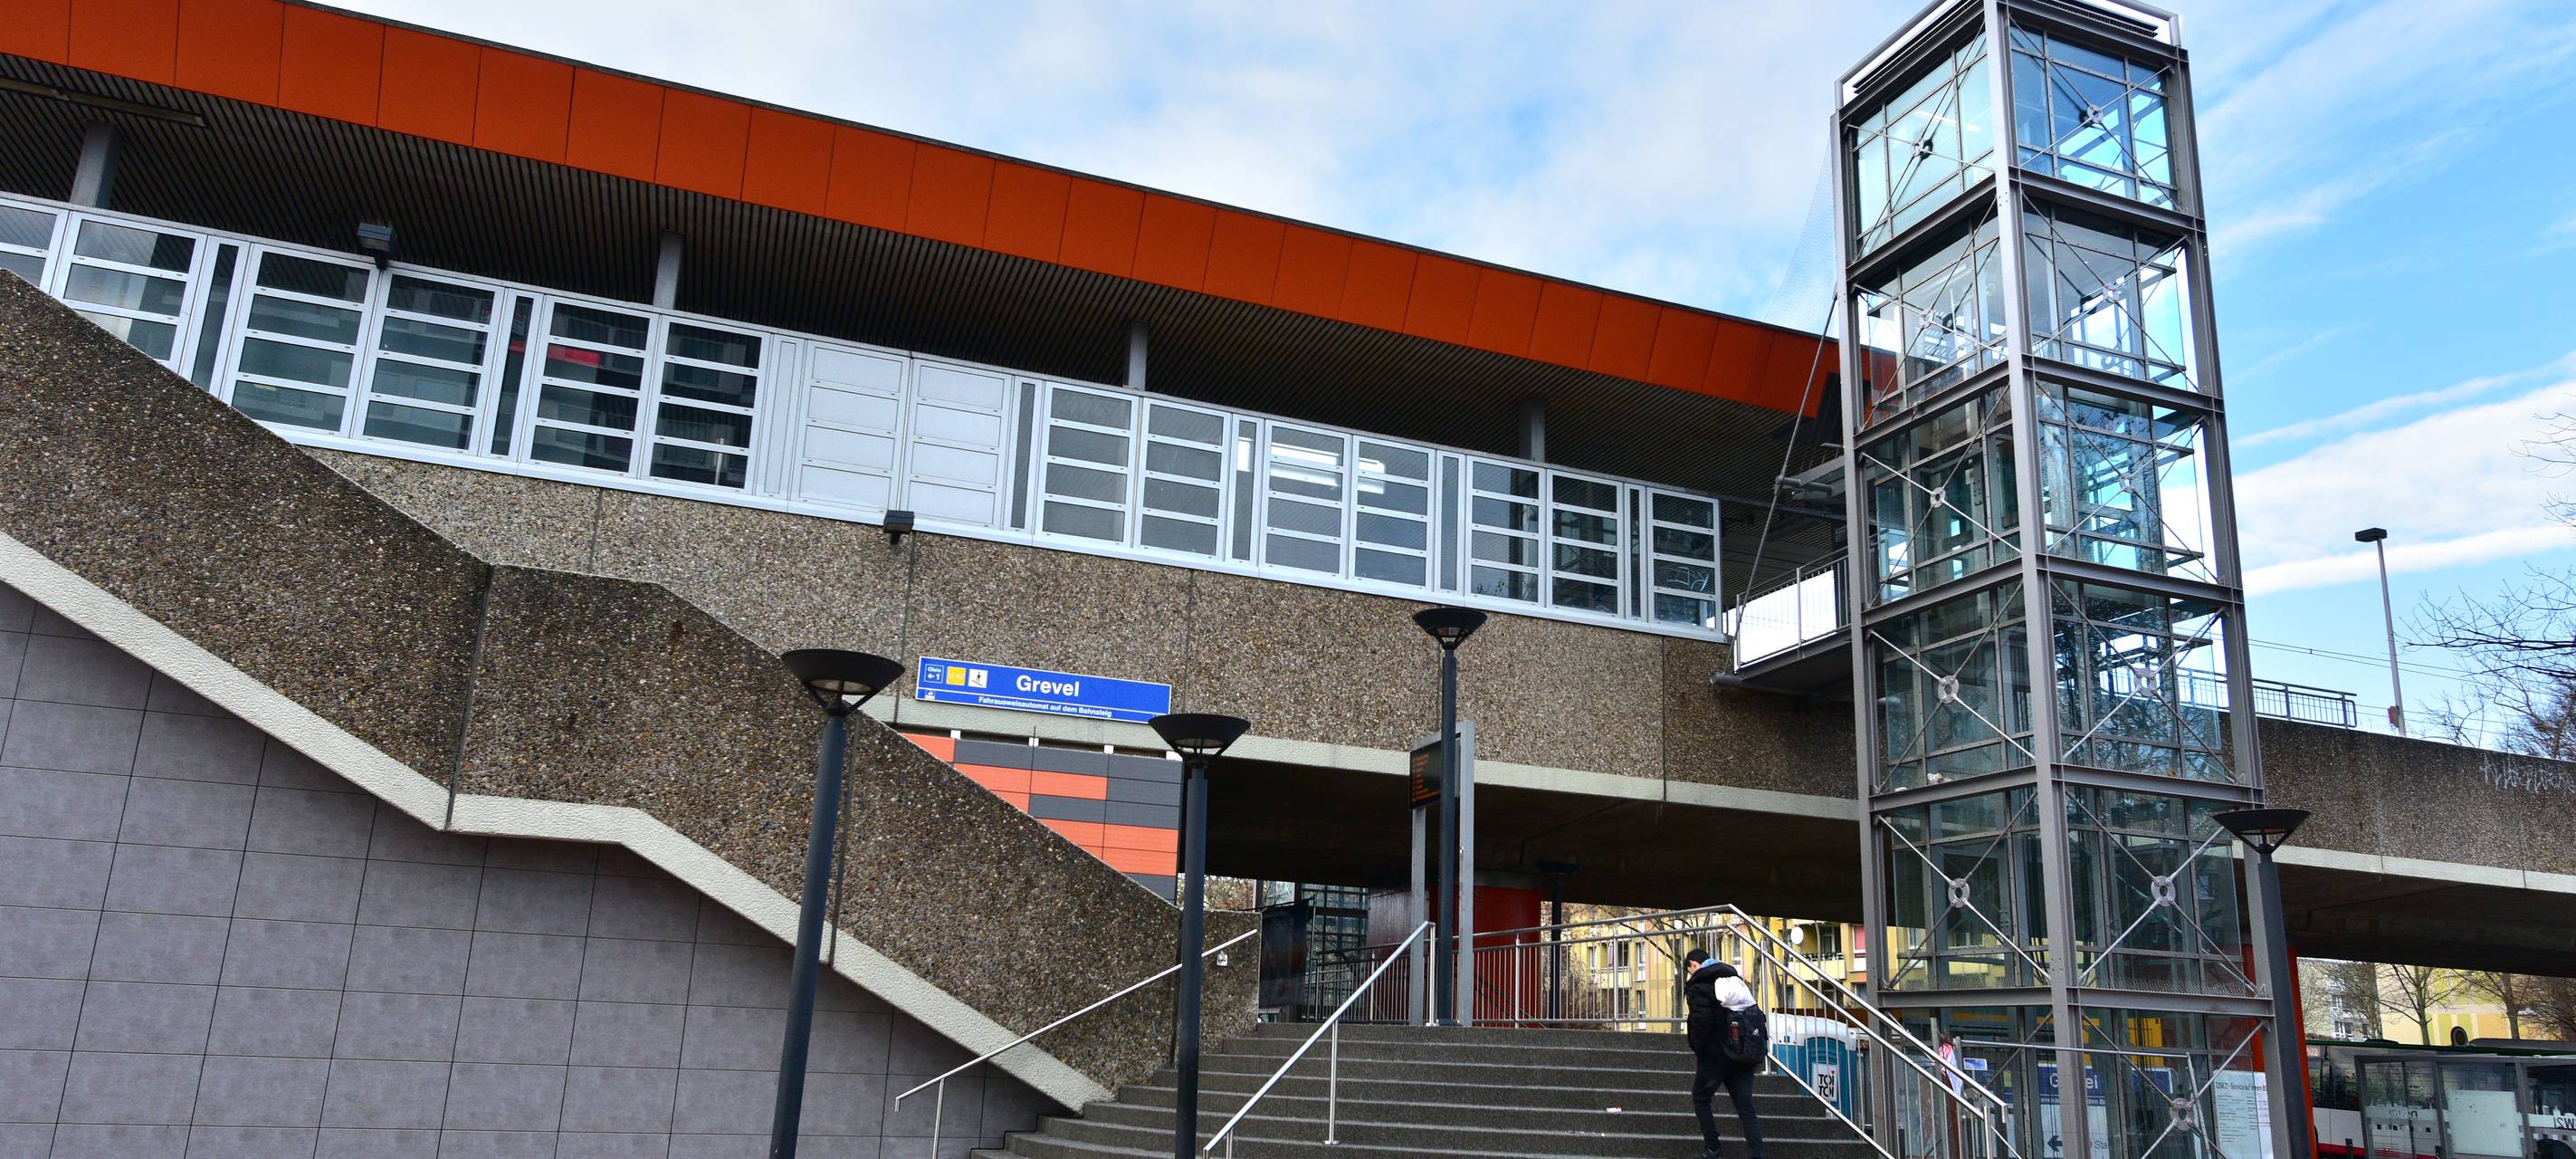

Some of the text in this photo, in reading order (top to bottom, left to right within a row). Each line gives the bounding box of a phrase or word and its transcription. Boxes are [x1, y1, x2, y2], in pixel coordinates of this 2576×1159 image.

[1016, 675, 1080, 697] Grevel
[978, 696, 1049, 711] Fahrausweisautomat
[1079, 708, 1112, 718] Bahnsteig
